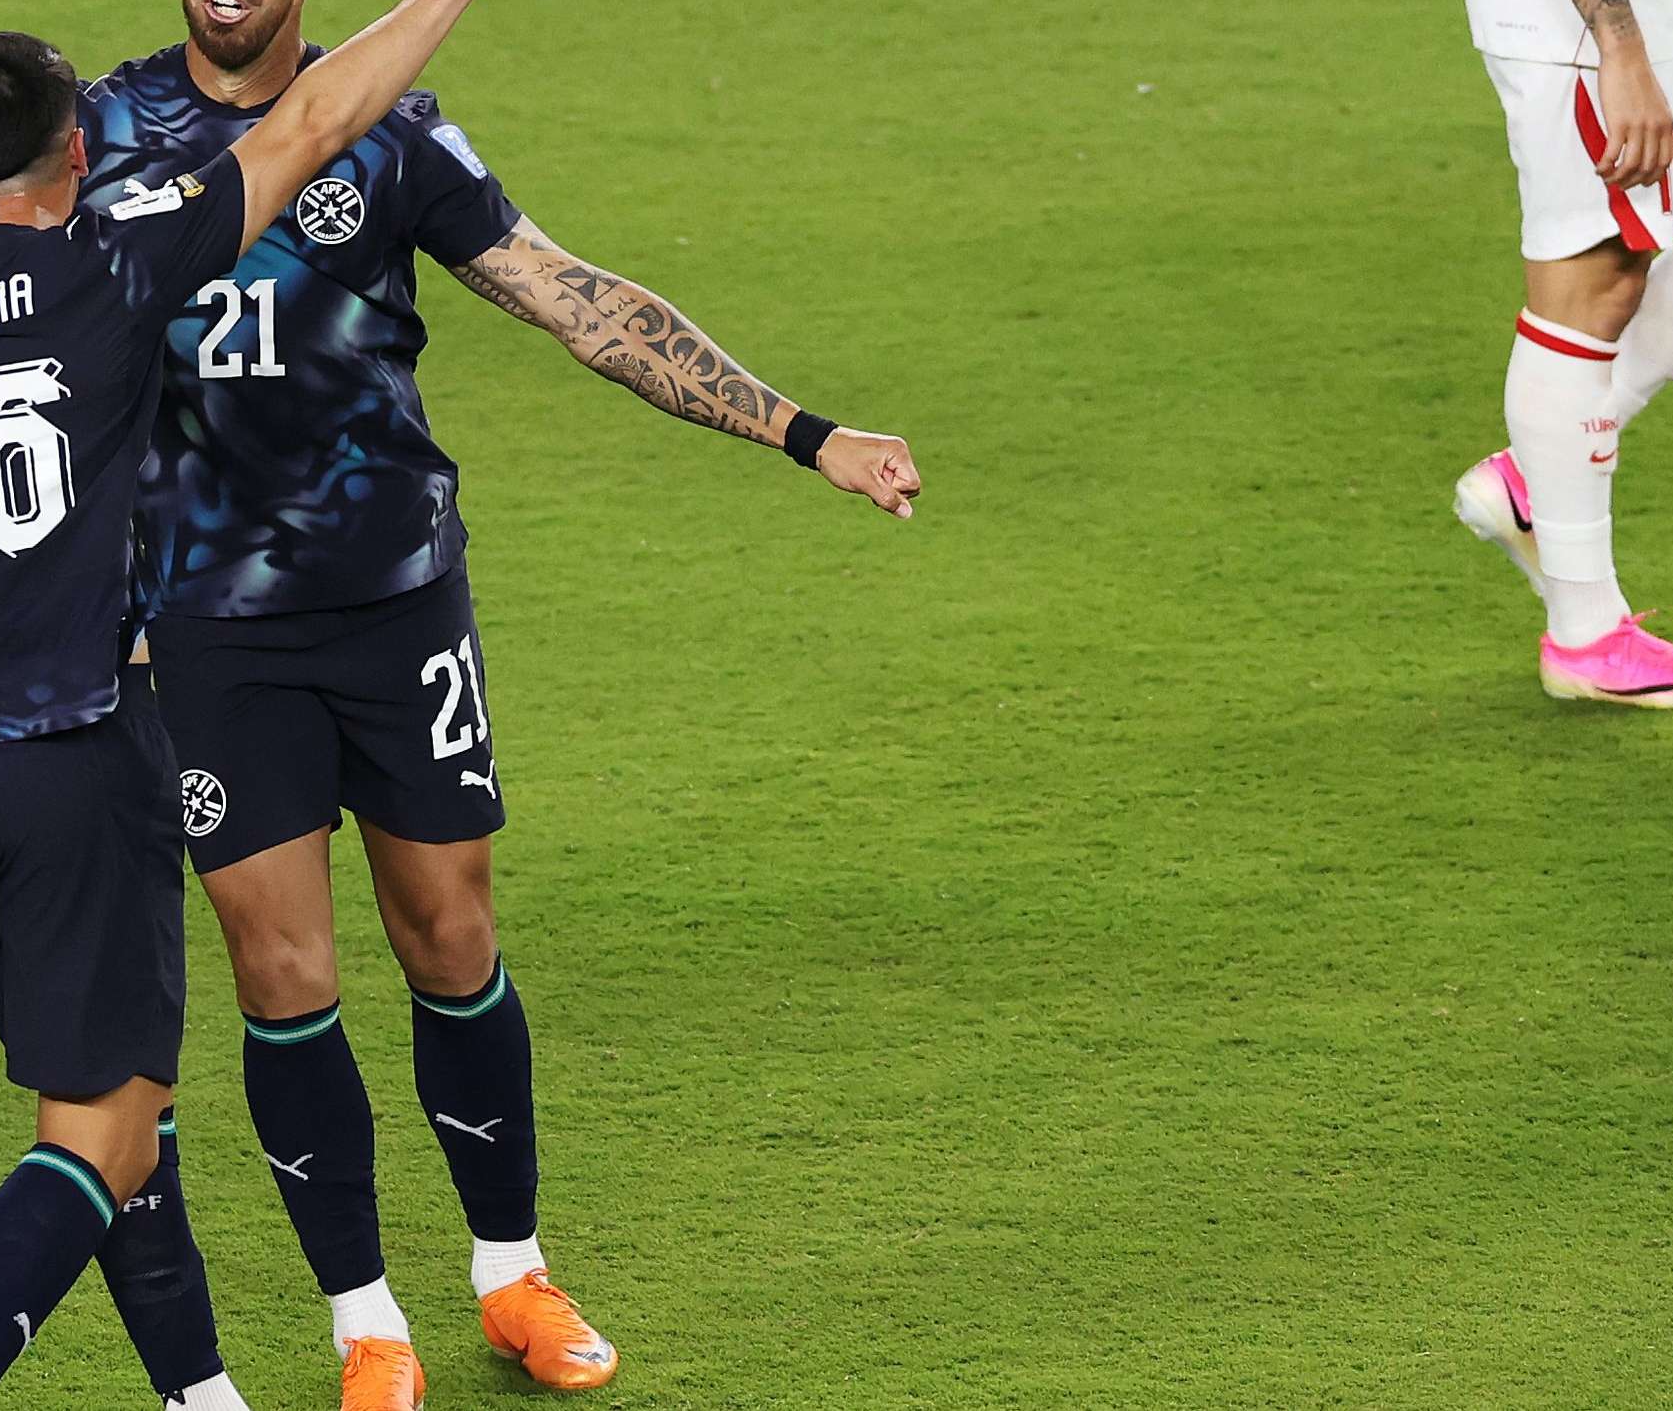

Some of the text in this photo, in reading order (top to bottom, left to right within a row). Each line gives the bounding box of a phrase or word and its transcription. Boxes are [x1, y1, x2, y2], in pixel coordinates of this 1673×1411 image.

[320, 183, 344, 196] APF
[197, 279, 286, 379] 21
[420, 633, 488, 760] 21
[123, 1194, 162, 1213] PF
